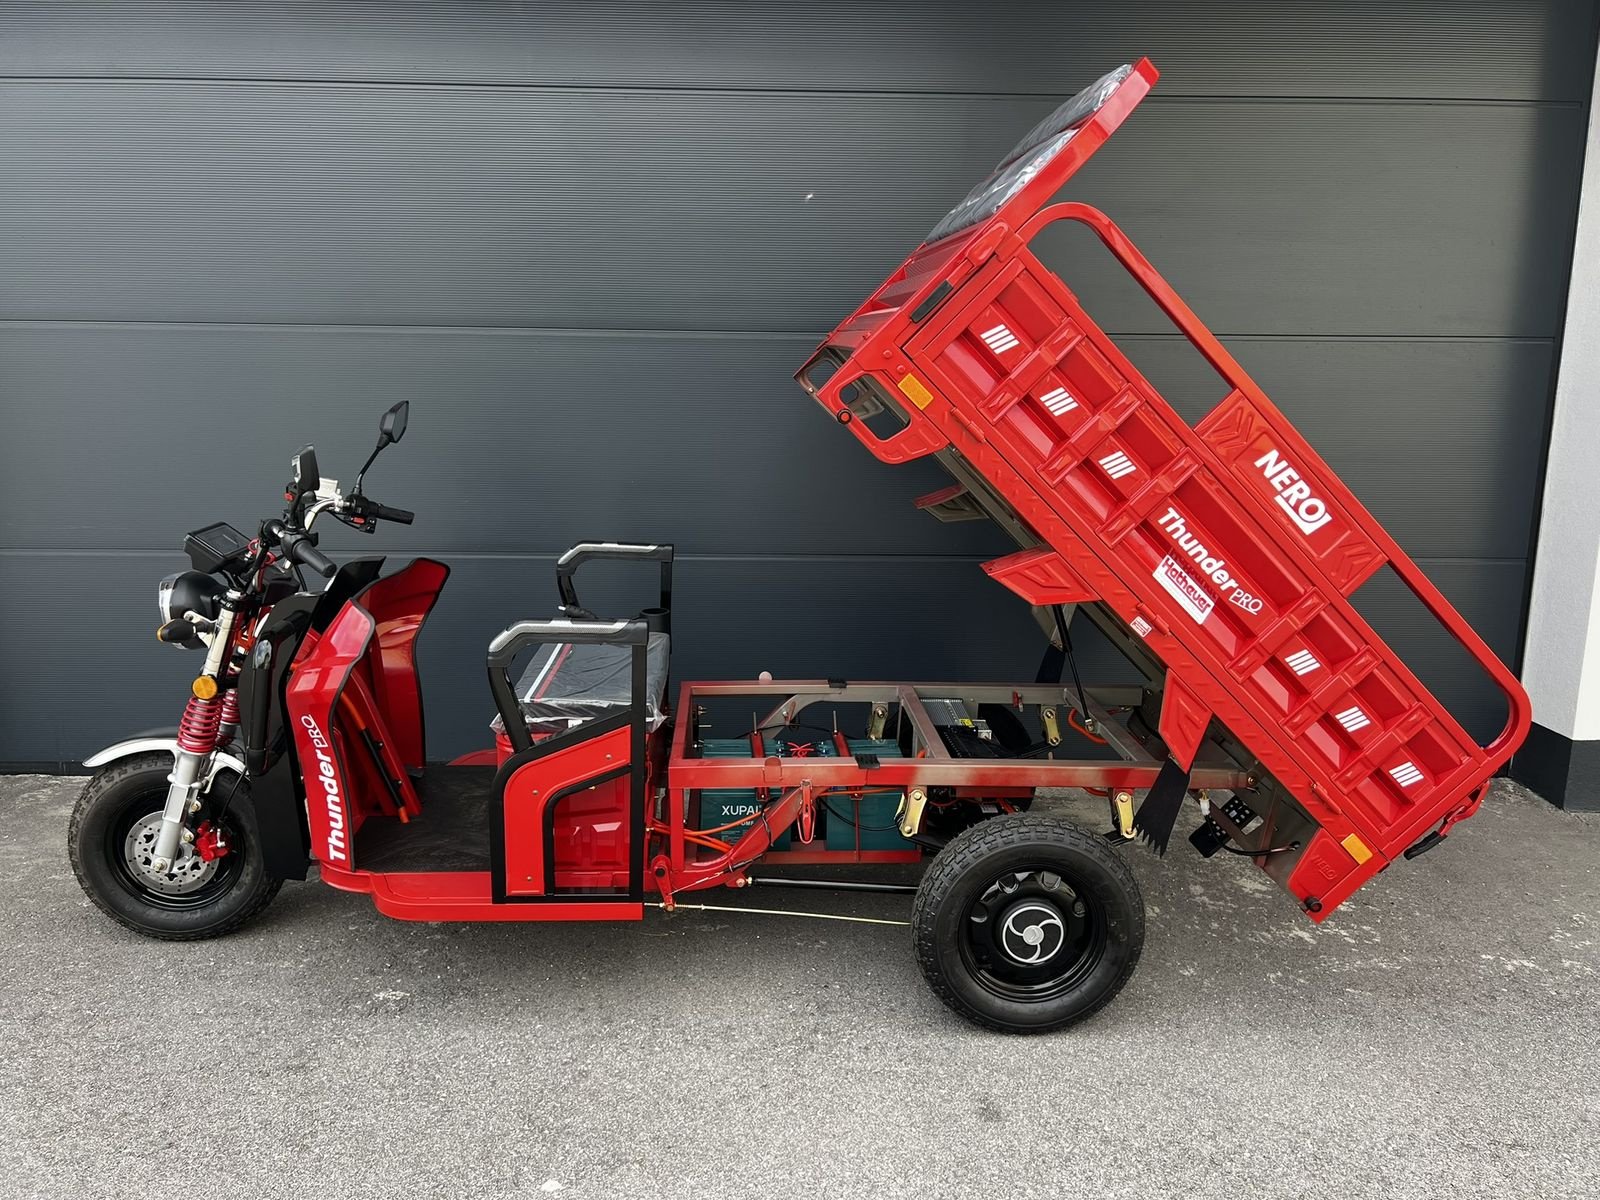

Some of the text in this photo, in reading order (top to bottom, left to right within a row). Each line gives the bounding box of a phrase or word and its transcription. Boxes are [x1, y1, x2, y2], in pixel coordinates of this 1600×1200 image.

[1254, 449, 1332, 535] NERO
[1158, 507, 1263, 615] Thunder PRO
[301, 714, 346, 861] Thunder PRO
